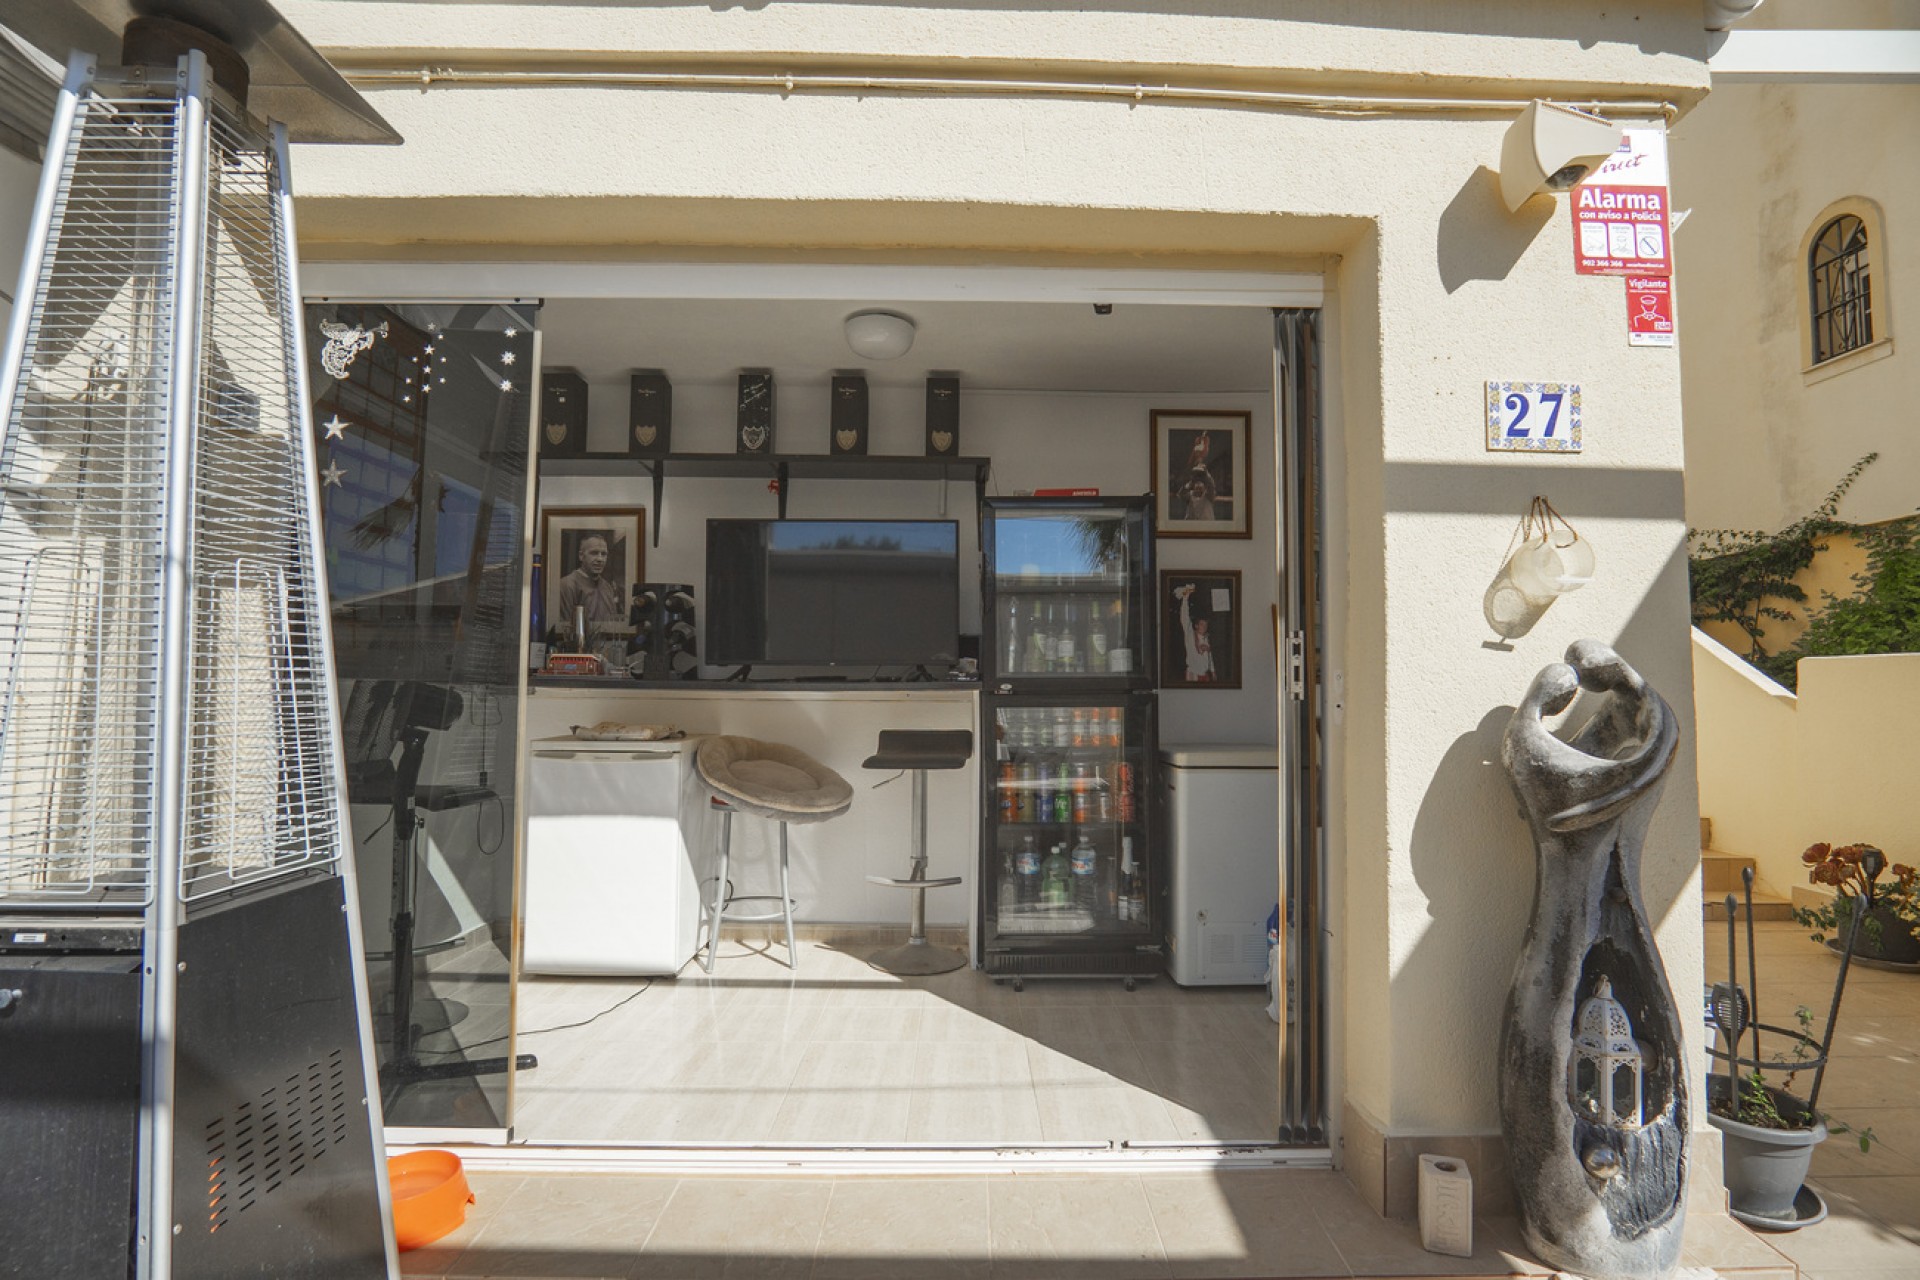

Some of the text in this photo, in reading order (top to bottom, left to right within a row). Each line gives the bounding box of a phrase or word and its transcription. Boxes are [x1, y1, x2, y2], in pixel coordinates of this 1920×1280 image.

[1602, 154, 1648, 173] irect
[1579, 188, 1660, 210] Alarma
[1579, 211, 1596, 219] con
[1598, 210, 1622, 219] aviso
[1629, 279, 1667, 289] Vigilante
[1505, 393, 1563, 437] 27
